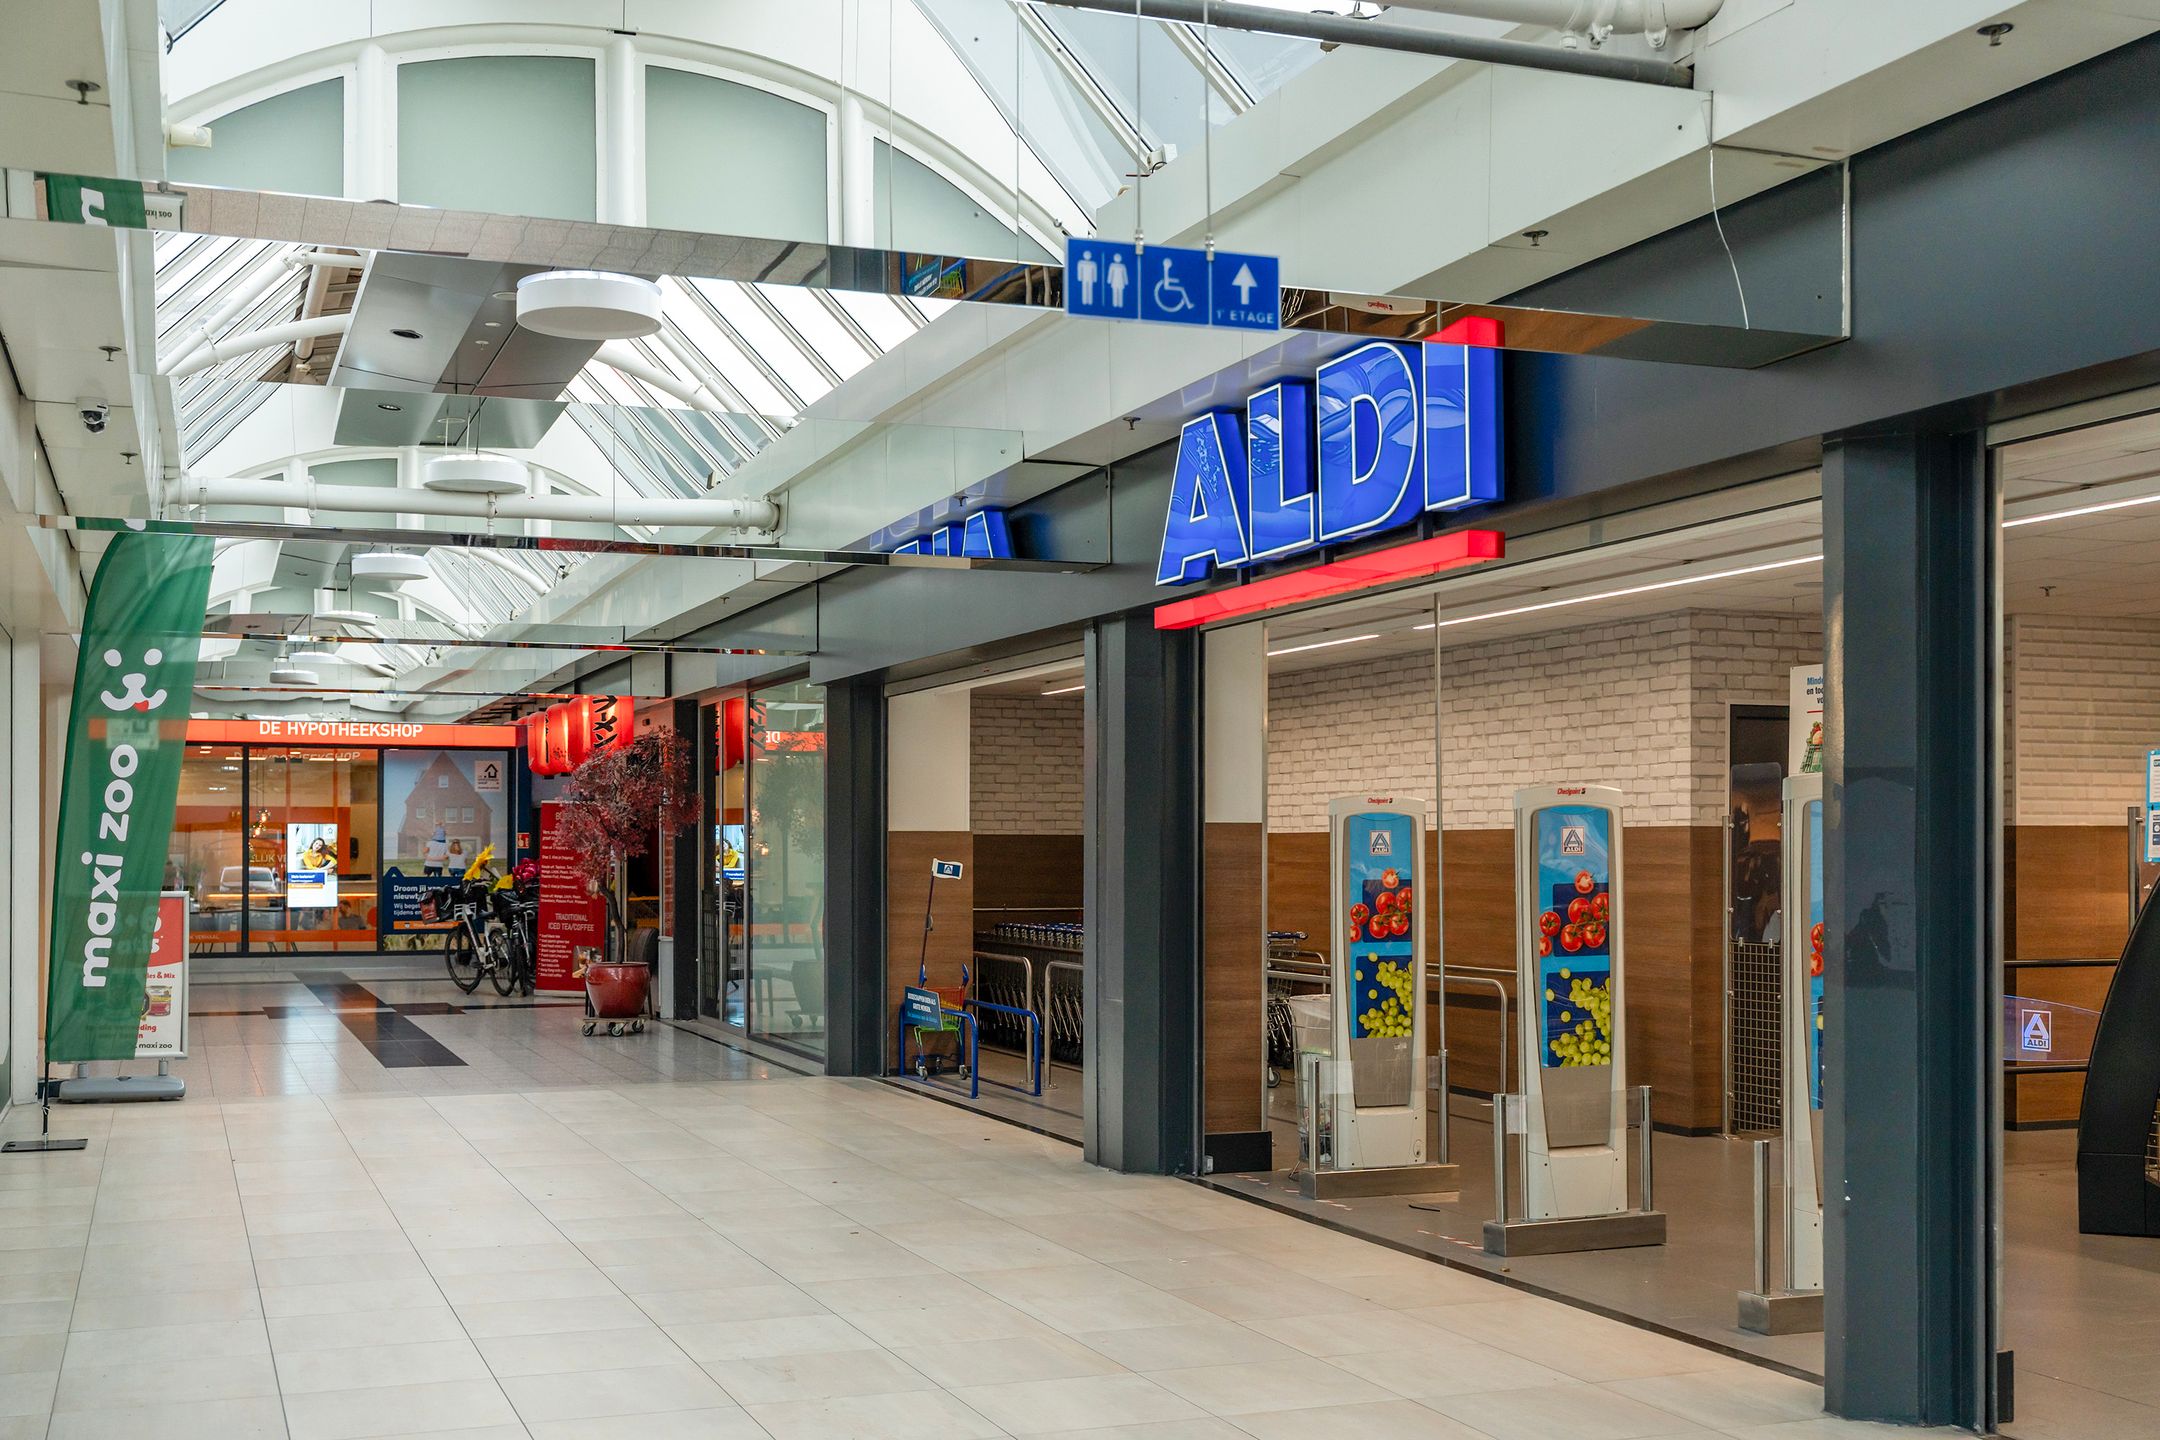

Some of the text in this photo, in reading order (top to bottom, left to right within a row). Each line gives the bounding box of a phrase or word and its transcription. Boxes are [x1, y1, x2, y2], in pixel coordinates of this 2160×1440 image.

[1230, 311, 1274, 324] ETAGE
[1155, 340, 1488, 586] ALDI
[1806, 687, 1814, 695] en
[259, 721, 423, 738] DE HYPOTHEEKSHOP
[81, 743, 139, 988] maxi zoo
[555, 912, 588, 922] TRADITIONAL
[548, 922, 594, 931] ICED TEA/COFFEE
